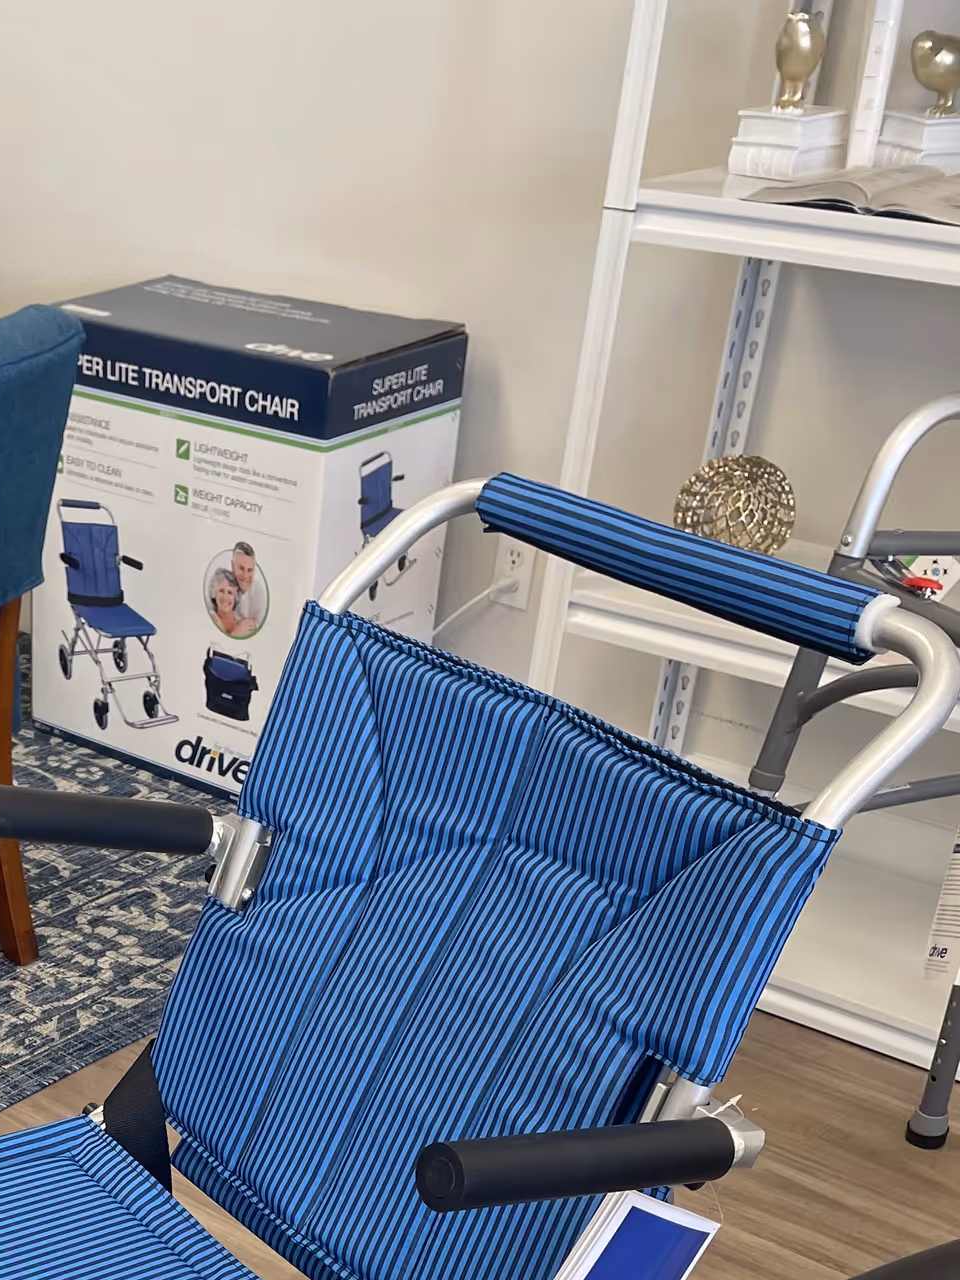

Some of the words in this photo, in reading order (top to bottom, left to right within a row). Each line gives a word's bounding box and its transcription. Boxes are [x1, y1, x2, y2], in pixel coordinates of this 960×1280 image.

[106, 360, 140, 386] LITE
[142, 367, 243, 409] TRANSPORT
[244, 389, 301, 421] CHAIR
[372, 371, 407, 395] SUPER
[407, 364, 429, 384] LITE
[353, 388, 413, 420] TRANSPORT
[413, 379, 444, 401] CHAIR
[65, 454, 85, 468] EASY
[85, 460, 96, 472] TO
[96, 463, 122, 478] CLEAN
[192, 440, 249, 463] LIGHTWEIGHT
[191, 487, 223, 504] WEIGHT
[223, 495, 263, 515] CAPACITY
[174, 735, 253, 785] drive
[928, 943, 948, 959] drive
